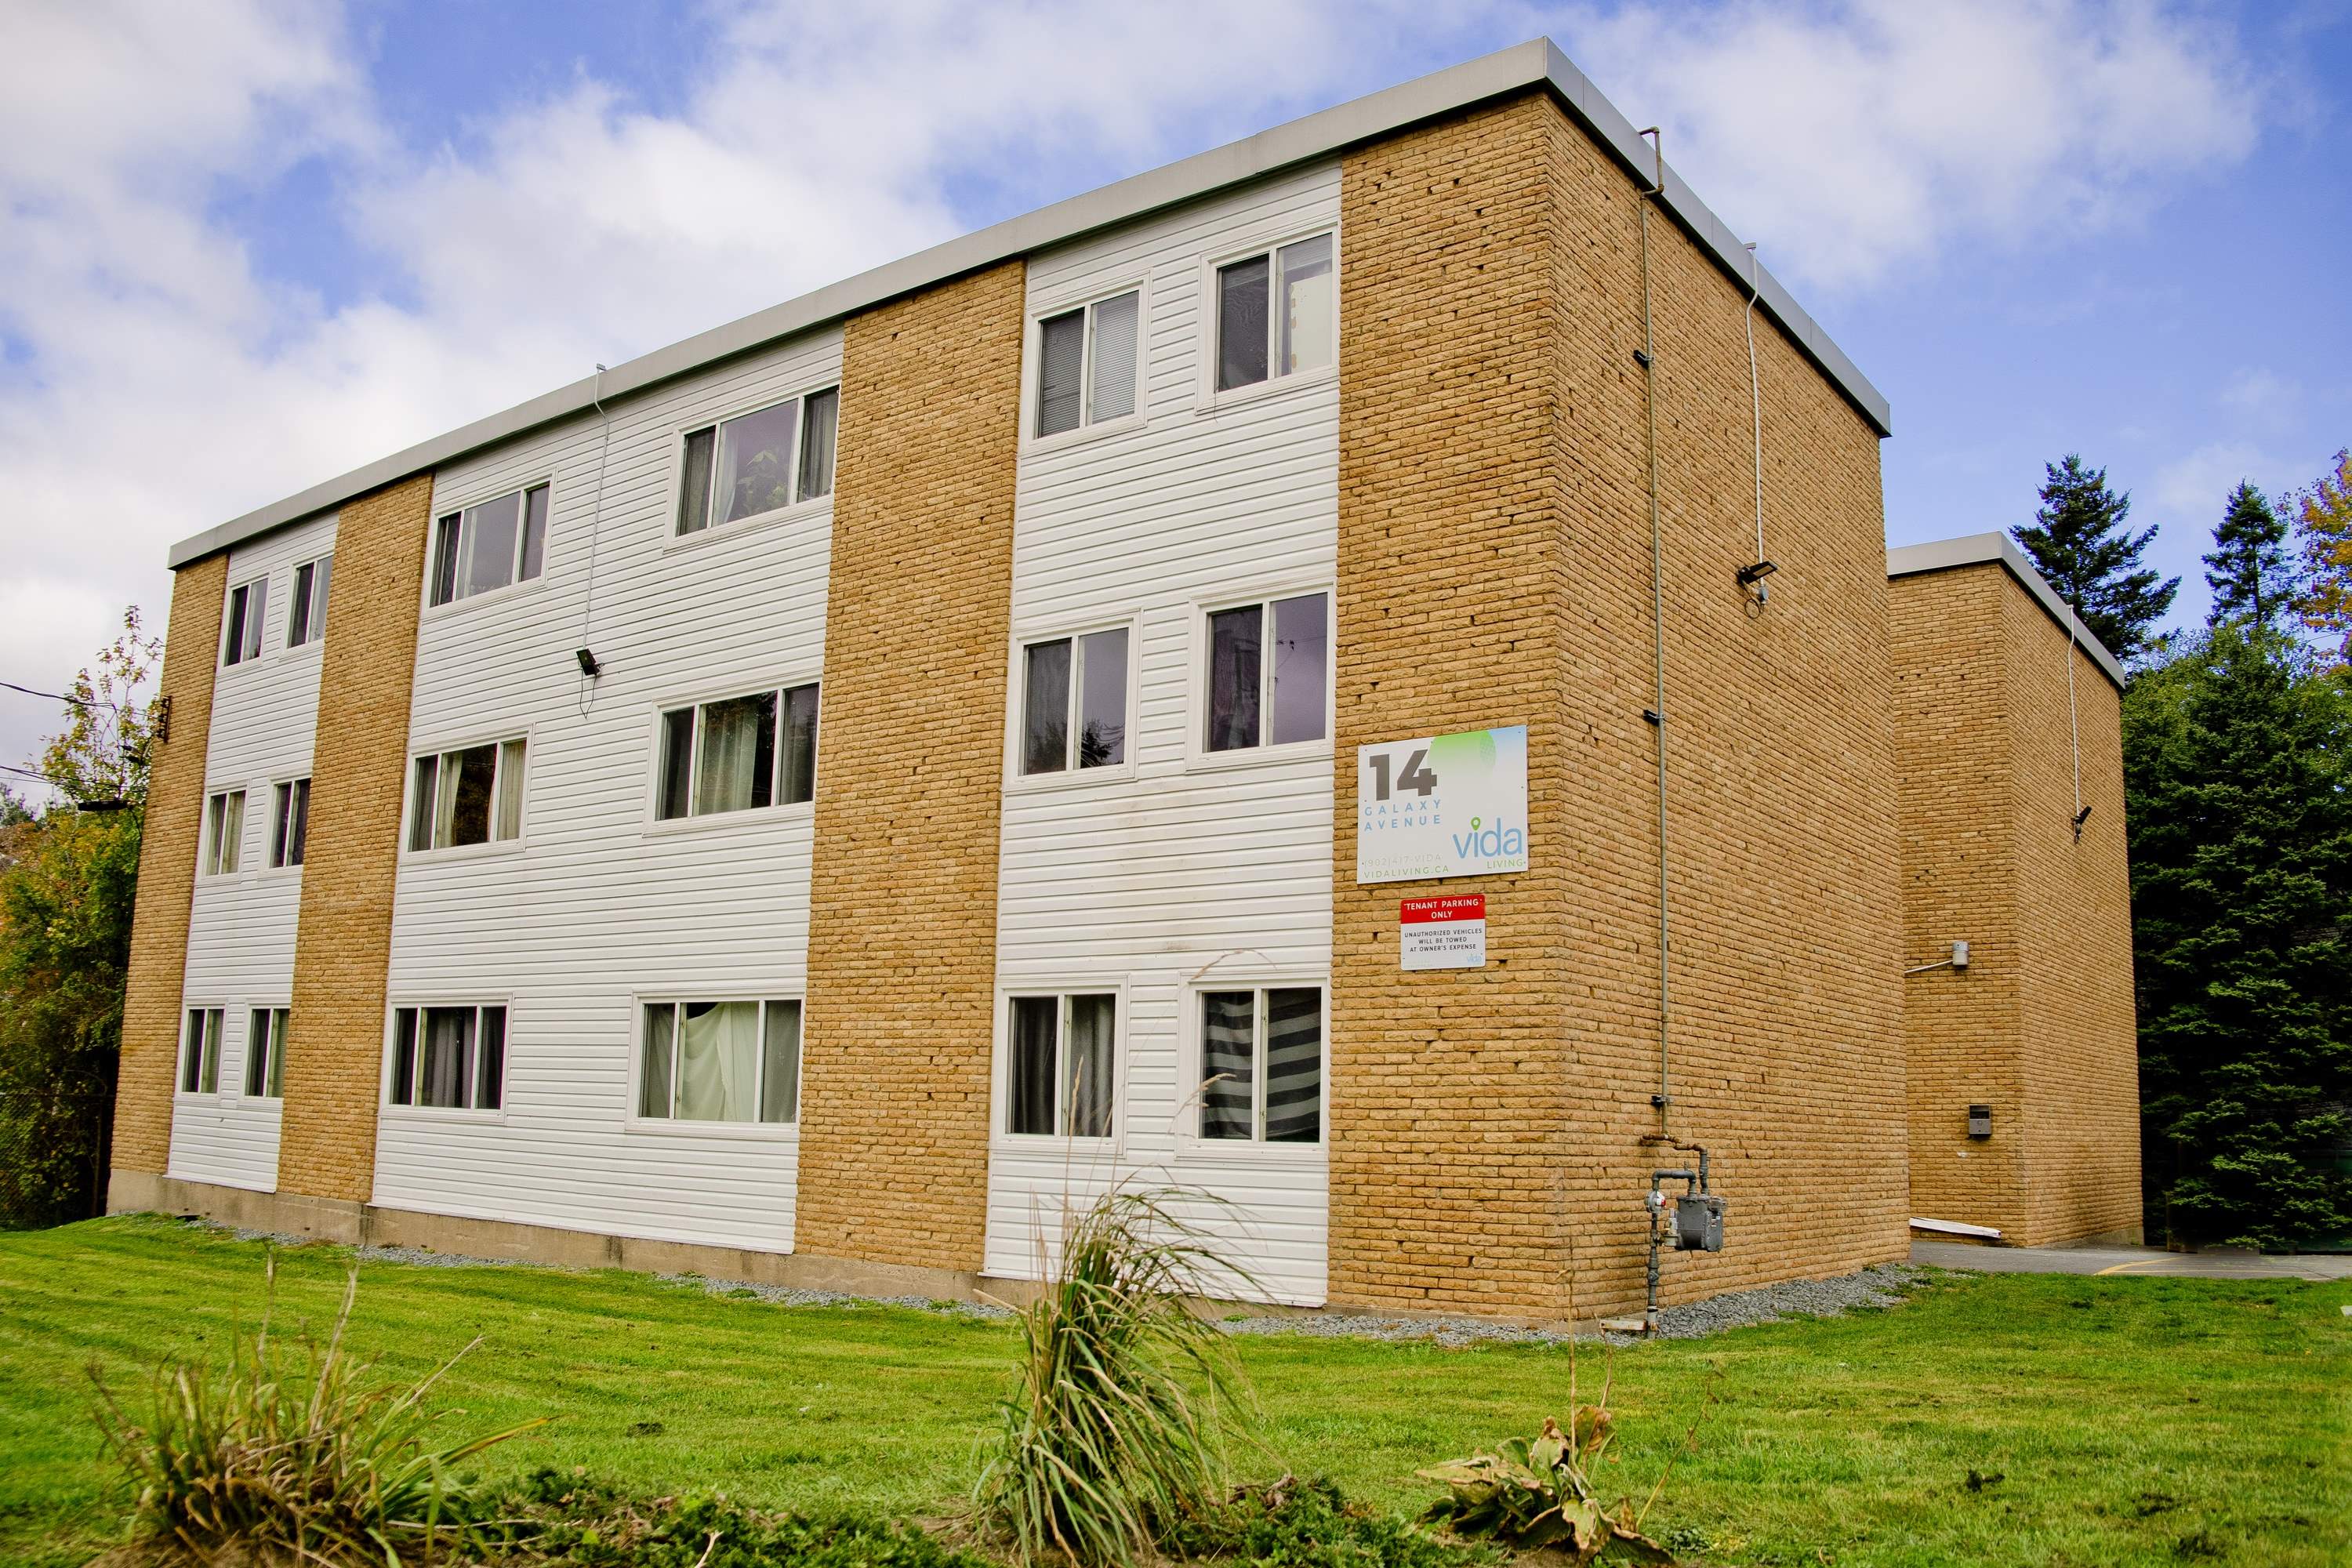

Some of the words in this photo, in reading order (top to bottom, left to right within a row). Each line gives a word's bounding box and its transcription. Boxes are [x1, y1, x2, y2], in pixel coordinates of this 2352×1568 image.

[1370, 749, 1437, 801] 14
[1364, 799, 1441, 816] GALAXY
[1364, 815, 1441, 832] AVENUE
[1452, 816, 1523, 858] vida
[1486, 858, 1523, 869] LIVING
[1363, 865, 1450, 879] VIDALIVING.CA
[1406, 901, 1438, 910] TENANT
[1441, 898, 1479, 908] PARKING
[1431, 910, 1453, 919] ONLY
